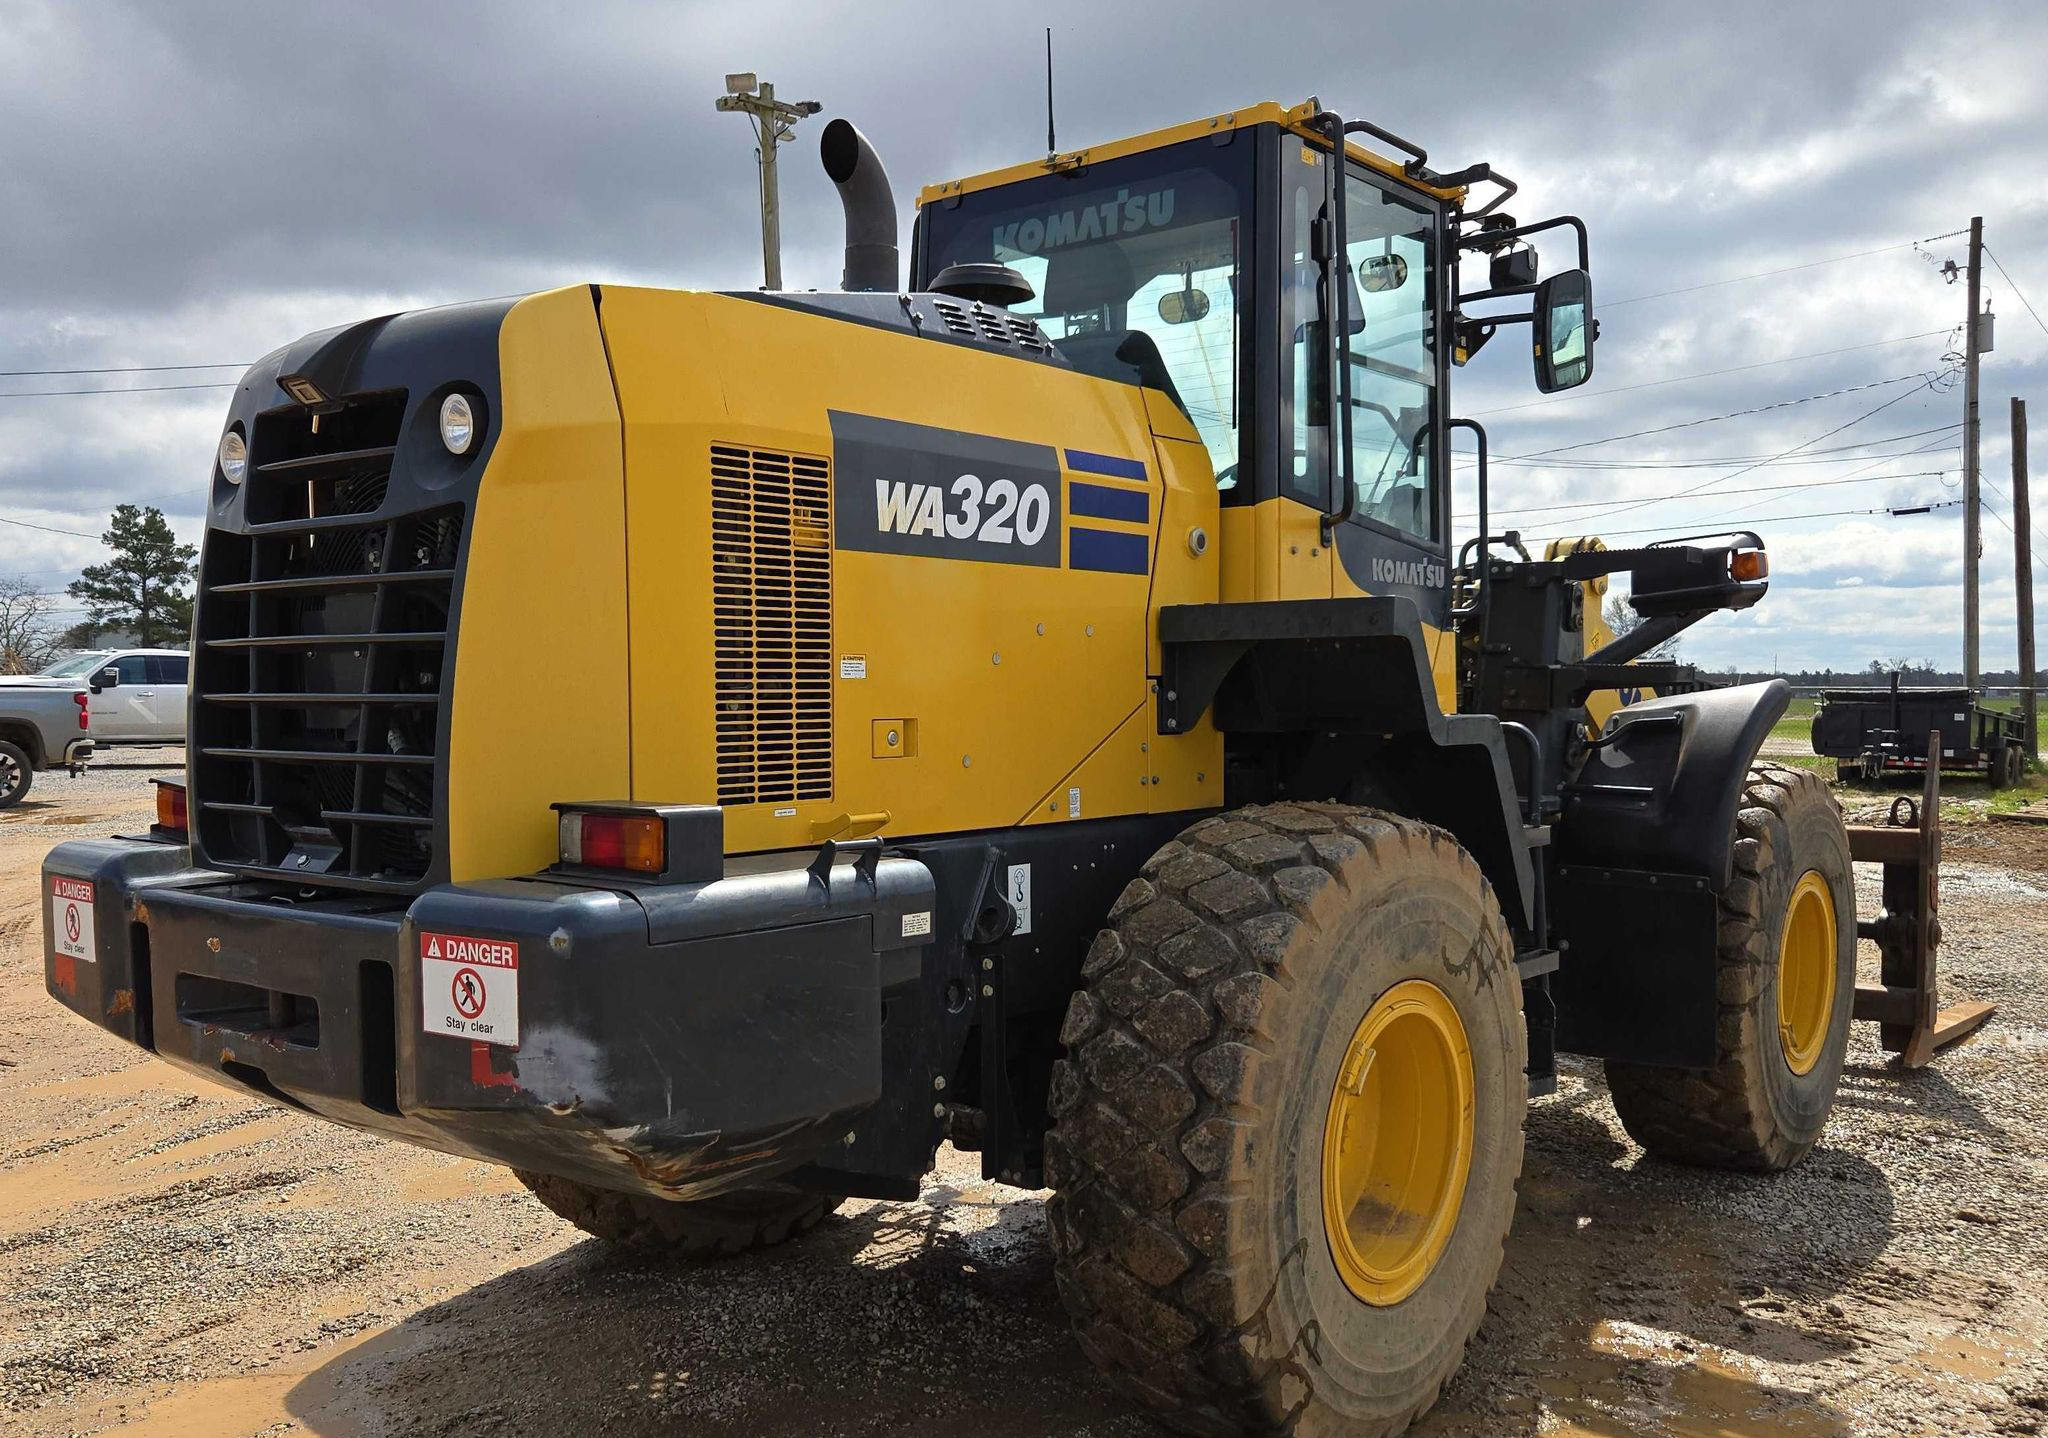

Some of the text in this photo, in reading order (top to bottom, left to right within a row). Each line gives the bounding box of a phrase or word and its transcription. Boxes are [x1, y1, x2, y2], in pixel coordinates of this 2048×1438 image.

[992, 189, 1175, 258] KOMATSU
[876, 474, 1050, 546] WA320
[1372, 557, 1445, 588] KOMATSU
[62, 882, 91, 900] DANGER
[63, 940, 73, 953] Stay
[446, 939, 513, 966] DANGER
[446, 1016, 494, 1034] Stay clear
